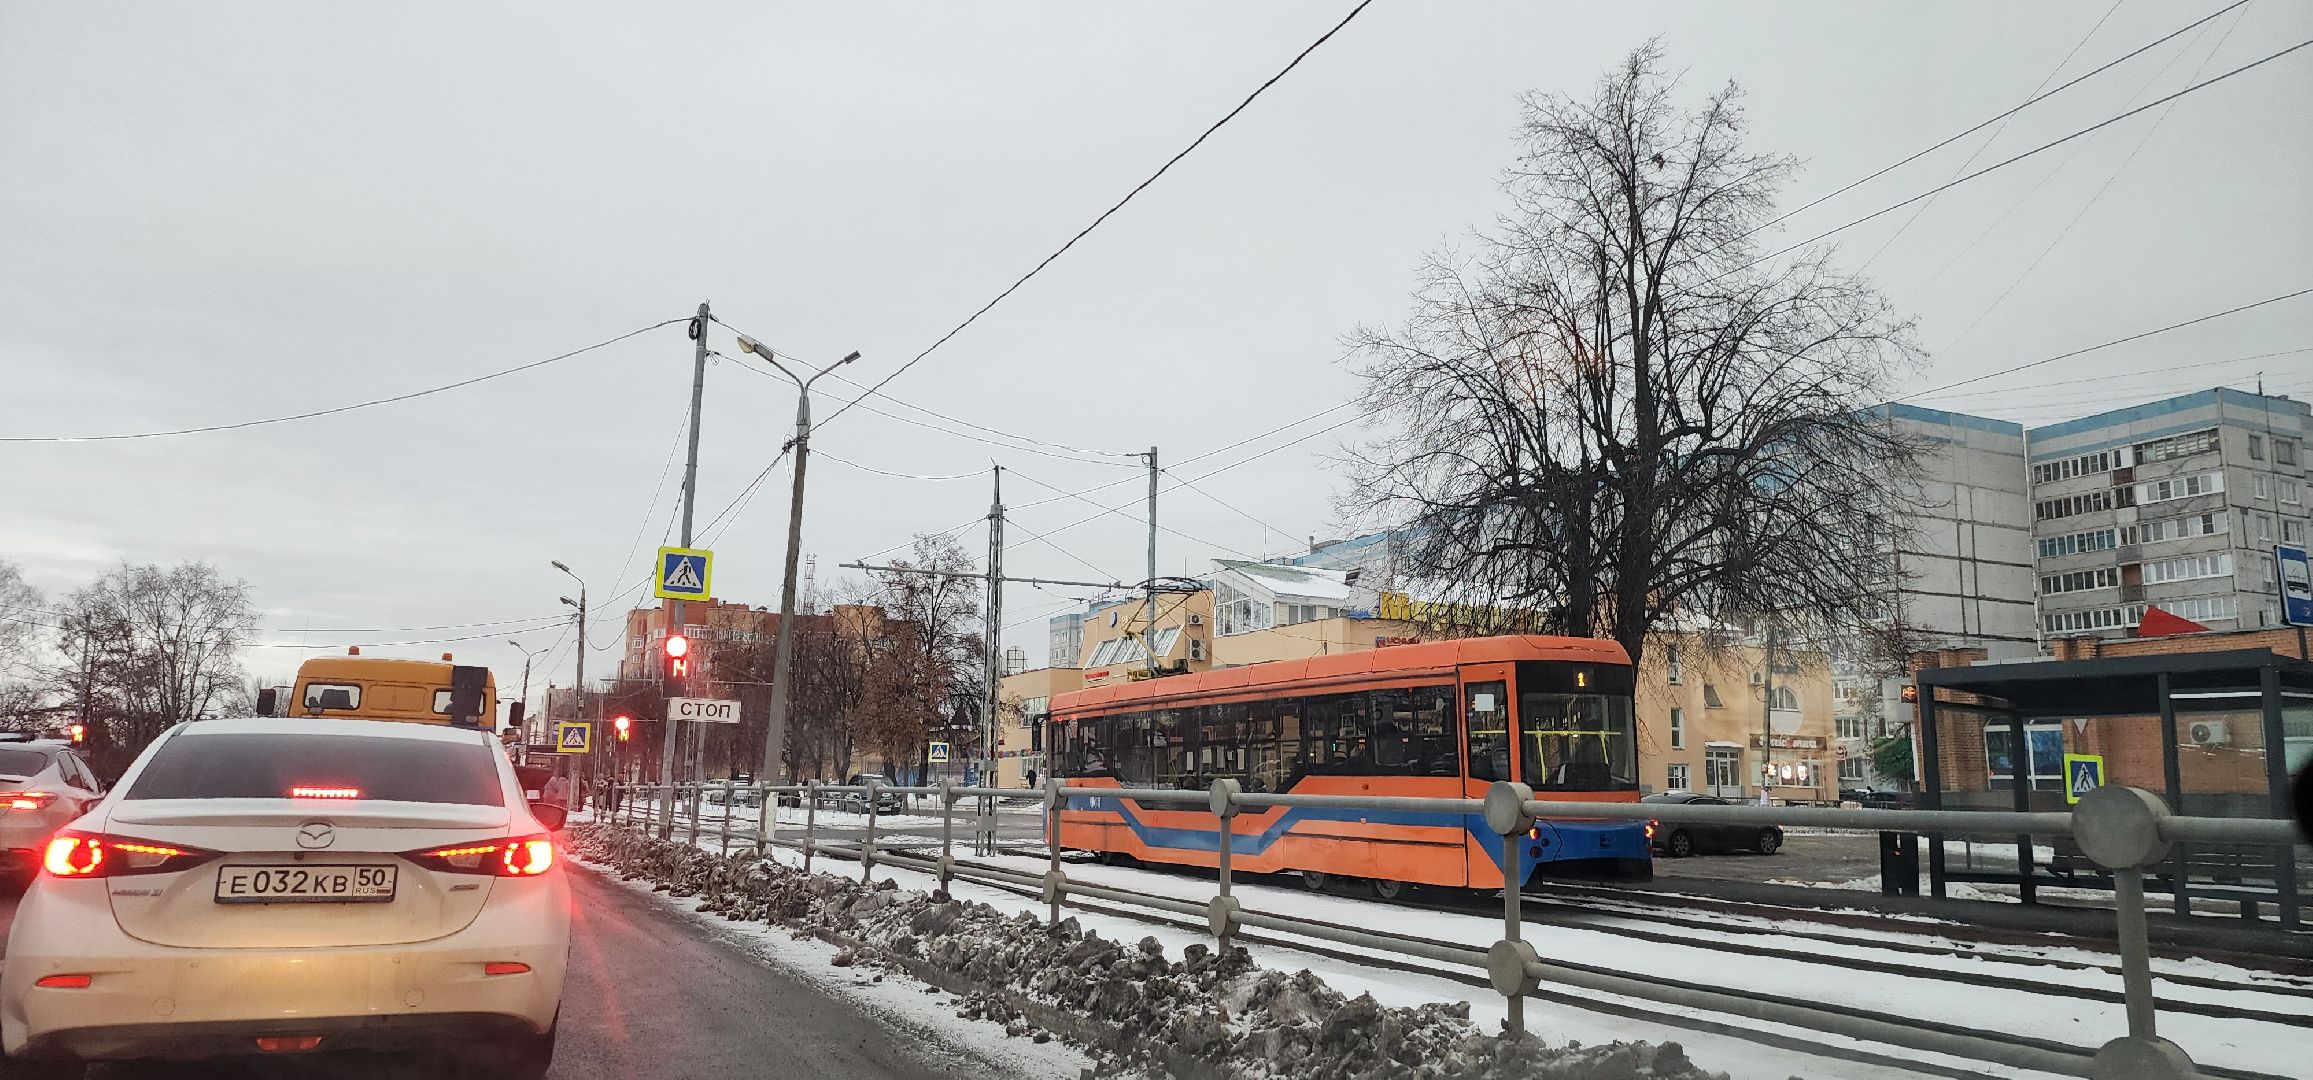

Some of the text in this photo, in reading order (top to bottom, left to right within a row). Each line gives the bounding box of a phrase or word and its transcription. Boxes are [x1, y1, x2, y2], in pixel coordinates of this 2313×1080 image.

[1577, 672, 1585, 686] 1
[680, 702, 731, 718] СТОП
[357, 868, 386, 887] 50
